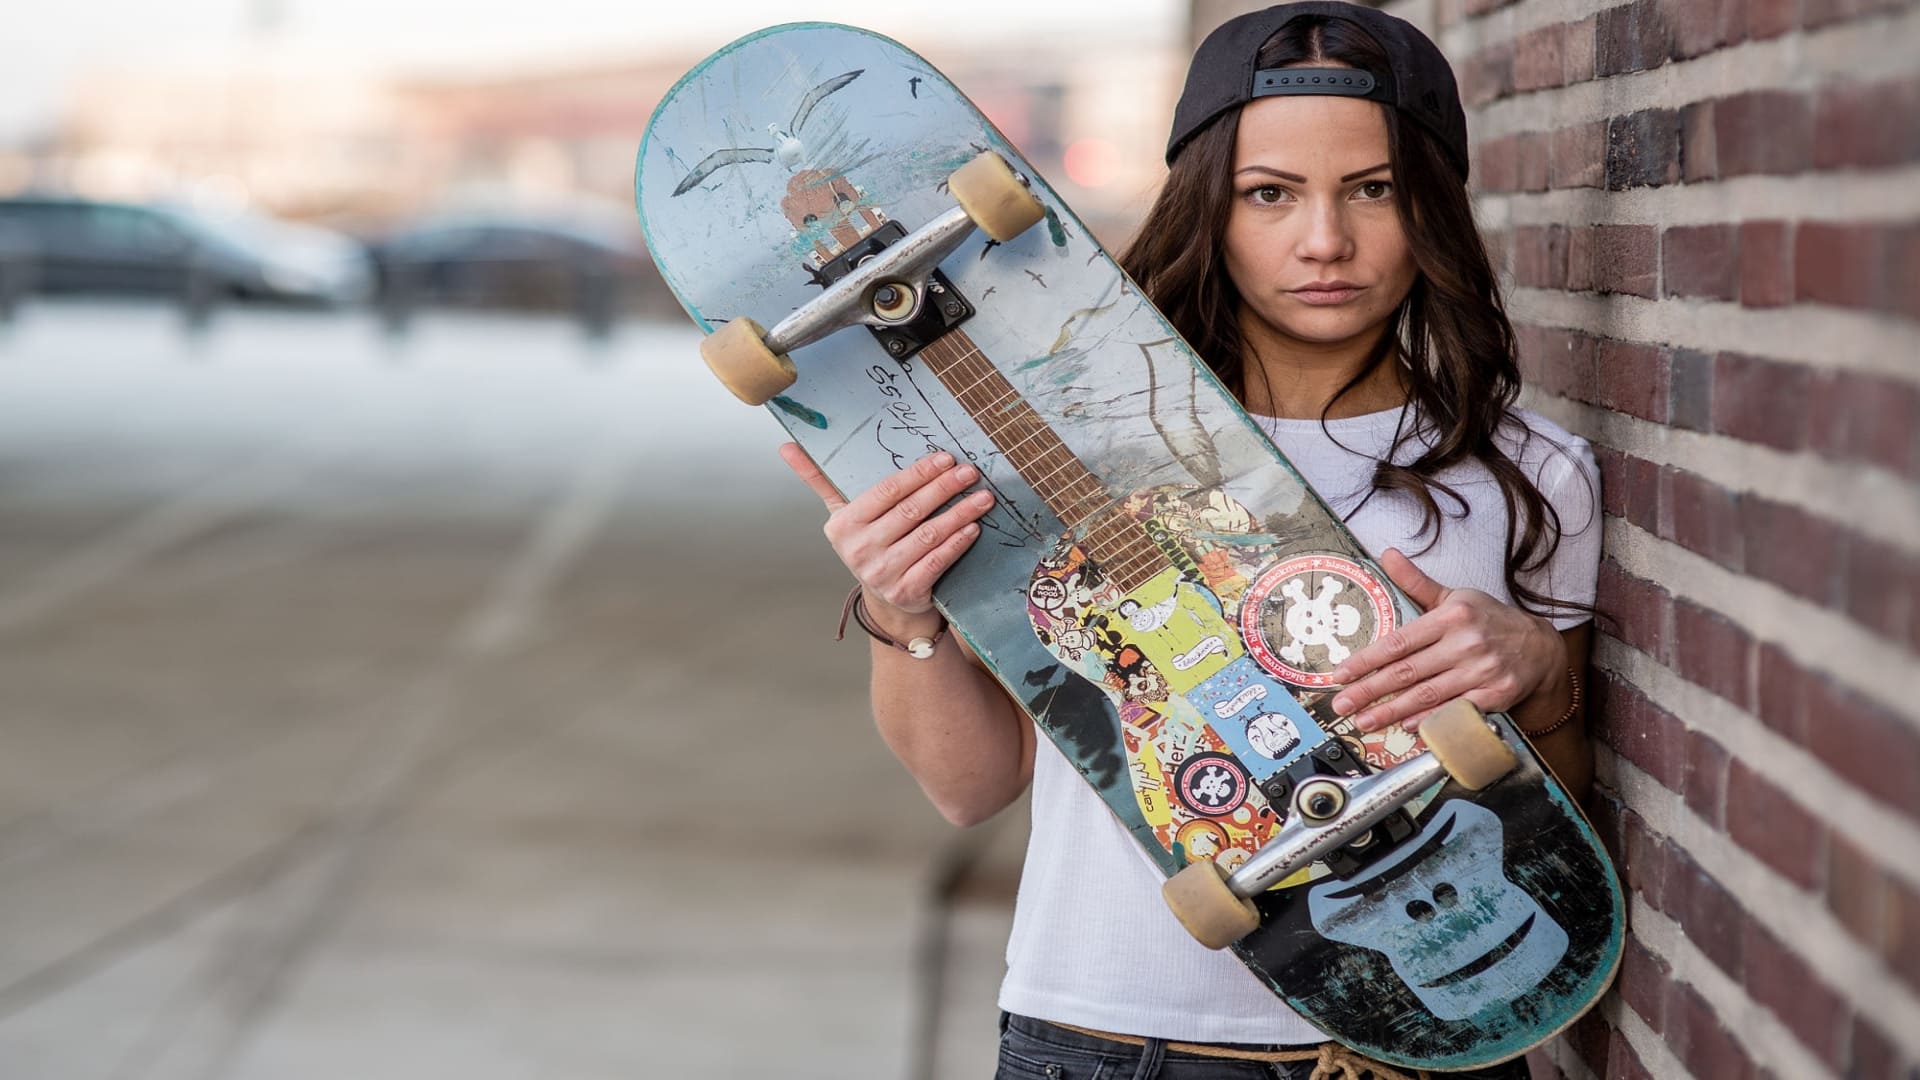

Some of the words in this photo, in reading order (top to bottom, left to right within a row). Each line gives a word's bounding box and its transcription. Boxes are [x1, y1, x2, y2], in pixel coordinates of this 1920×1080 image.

[1262, 561, 1307, 587] blackriver
[1325, 559, 1373, 585] blackriver
[1262, 654, 1306, 683] blackriver
